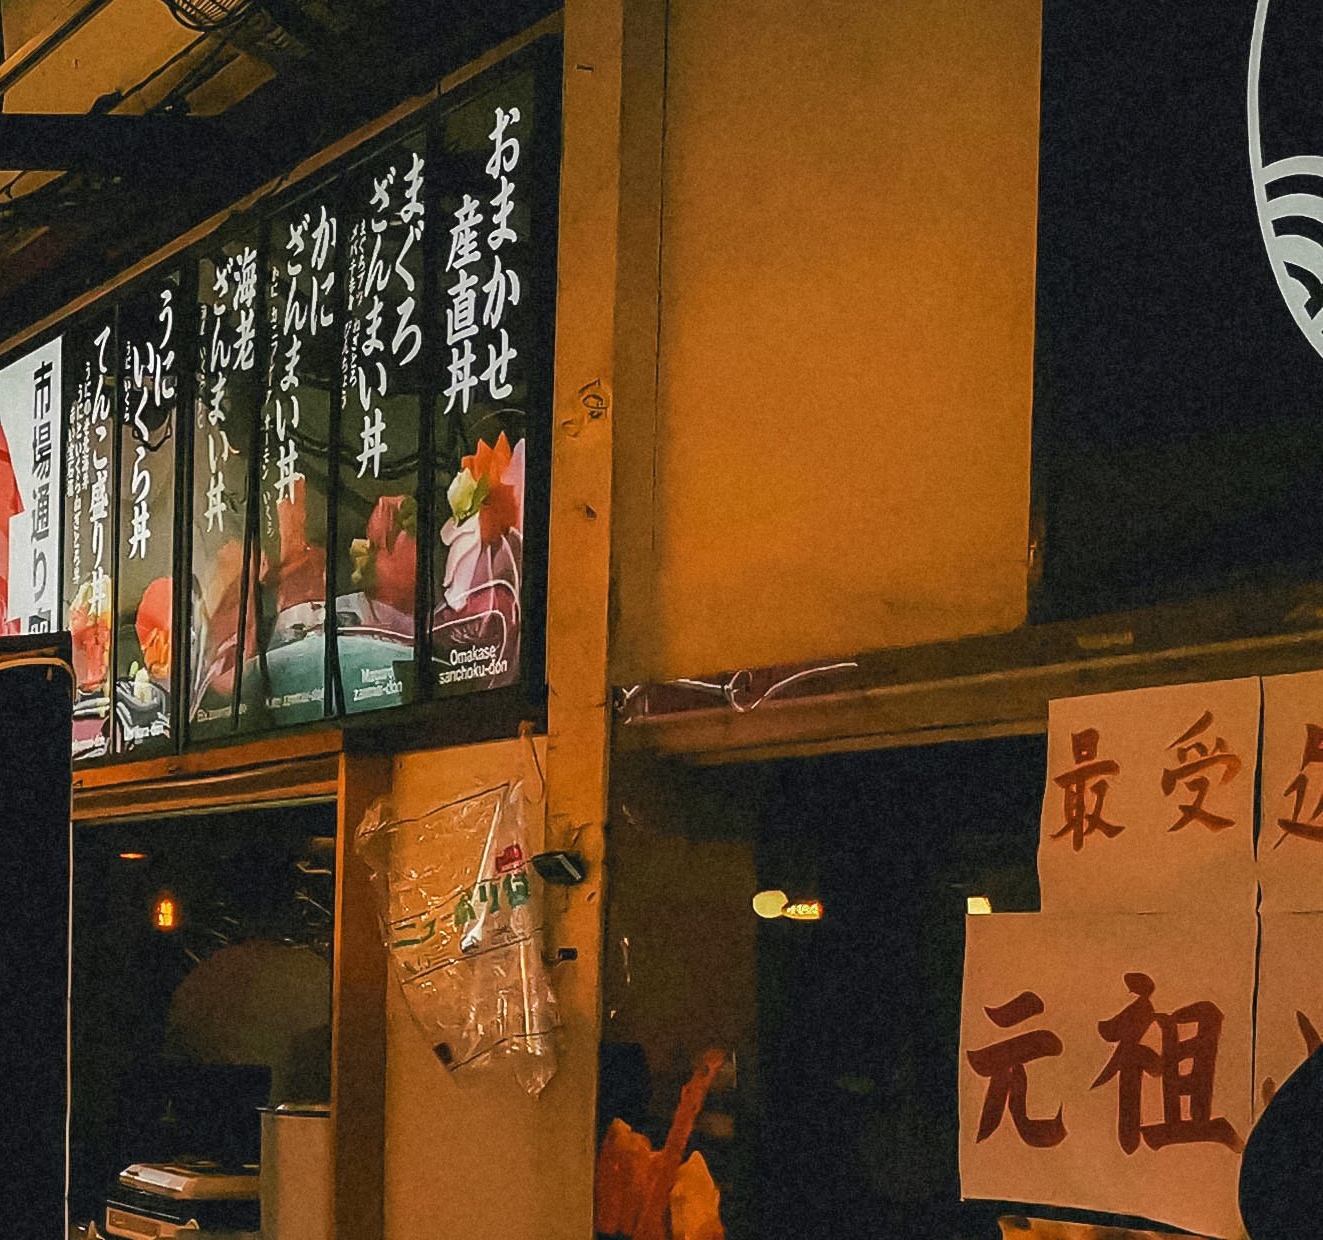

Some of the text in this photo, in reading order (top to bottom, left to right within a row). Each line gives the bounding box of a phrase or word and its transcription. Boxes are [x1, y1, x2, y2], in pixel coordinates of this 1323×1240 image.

[156, 288, 175, 408] うに
[233, 246, 257, 371] 海老
[274, 213, 310, 505] ざんまい丼
[311, 205, 337, 337] かに
[356, 166, 396, 479] ざんまい丼
[391, 152, 426, 367] まぐろ
[443, 193, 484, 415] 産直丼
[480, 106, 521, 400] おまかせ
[128, 341, 155, 560] いくら丼
[204, 256, 233, 534] ざんまい丼
[449, 644, 497, 666] Omakase
